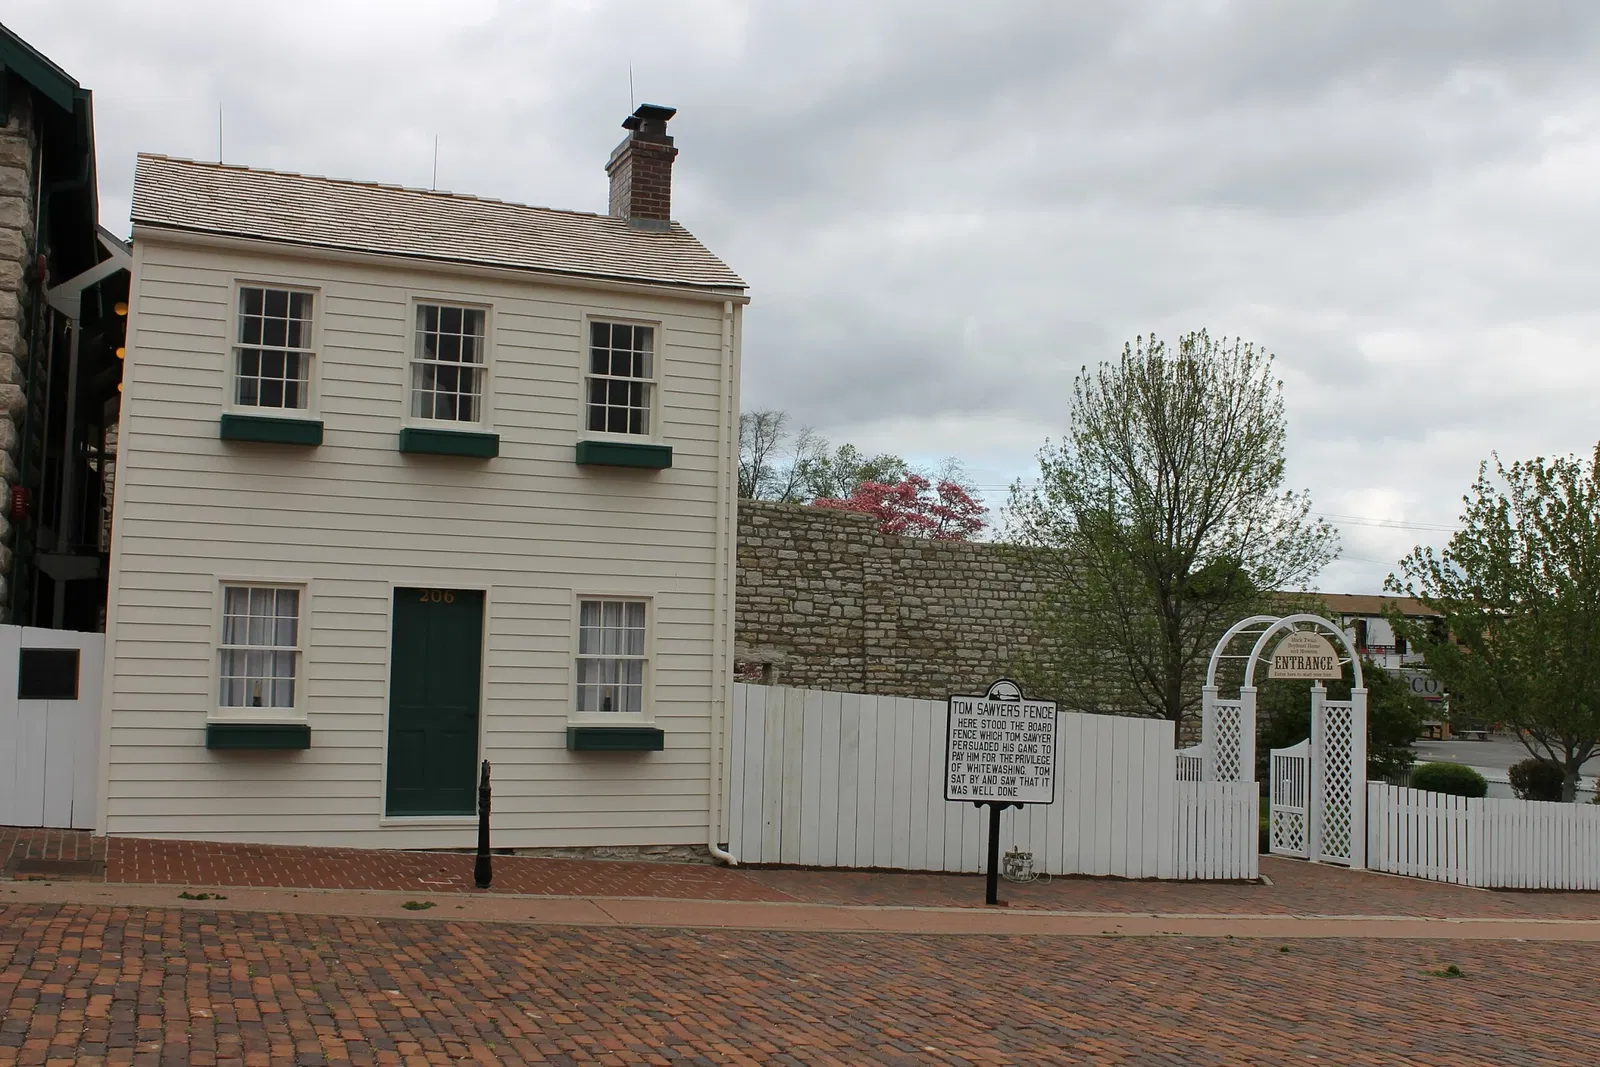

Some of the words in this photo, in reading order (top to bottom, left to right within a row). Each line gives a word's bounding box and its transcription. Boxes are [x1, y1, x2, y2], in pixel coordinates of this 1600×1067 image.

[419, 589, 455, 603] 206
[1275, 656, 1333, 670] ENTRANCE
[953, 701, 972, 715] TOM
[977, 703, 1020, 717] SAWYER'S
[1023, 705, 1054, 720] FENCE
[958, 718, 978, 729] HERE
[981, 719, 1007, 730] STOOD
[1011, 721, 1025, 731] THE
[1028, 722, 1052, 732] BOARD
[953, 729, 977, 740] FENCE
[980, 731, 1002, 741] WHICH
[1005, 732, 1021, 742] TOM
[1023, 733, 1051, 743] SAWYER
[952, 740, 999, 752] PERSUADED
[1002, 743, 1014, 752] HIS
[1018, 744, 1038, 753] GANG
[1042, 745, 1051, 754] TO
[951, 752, 965, 761] PAY
[967, 752, 979, 762] HIM
[982, 753, 996, 763] FOR
[999, 754, 1013, 763] THE
[1015, 754, 1051, 765] PRIVILEGE
[951, 763, 962, 772] OF
[1034, 766, 1050, 776] TOM
[951, 774, 966, 784] SAT
[970, 775, 979, 784] BY
[982, 775, 997, 785] AND
[1000, 776, 1016, 785] SAW
[1019, 777, 1039, 786] THAT
[1041, 778, 1050, 787] IT
[950, 785, 968, 795] WAS
[972, 786, 994, 796] WELL
